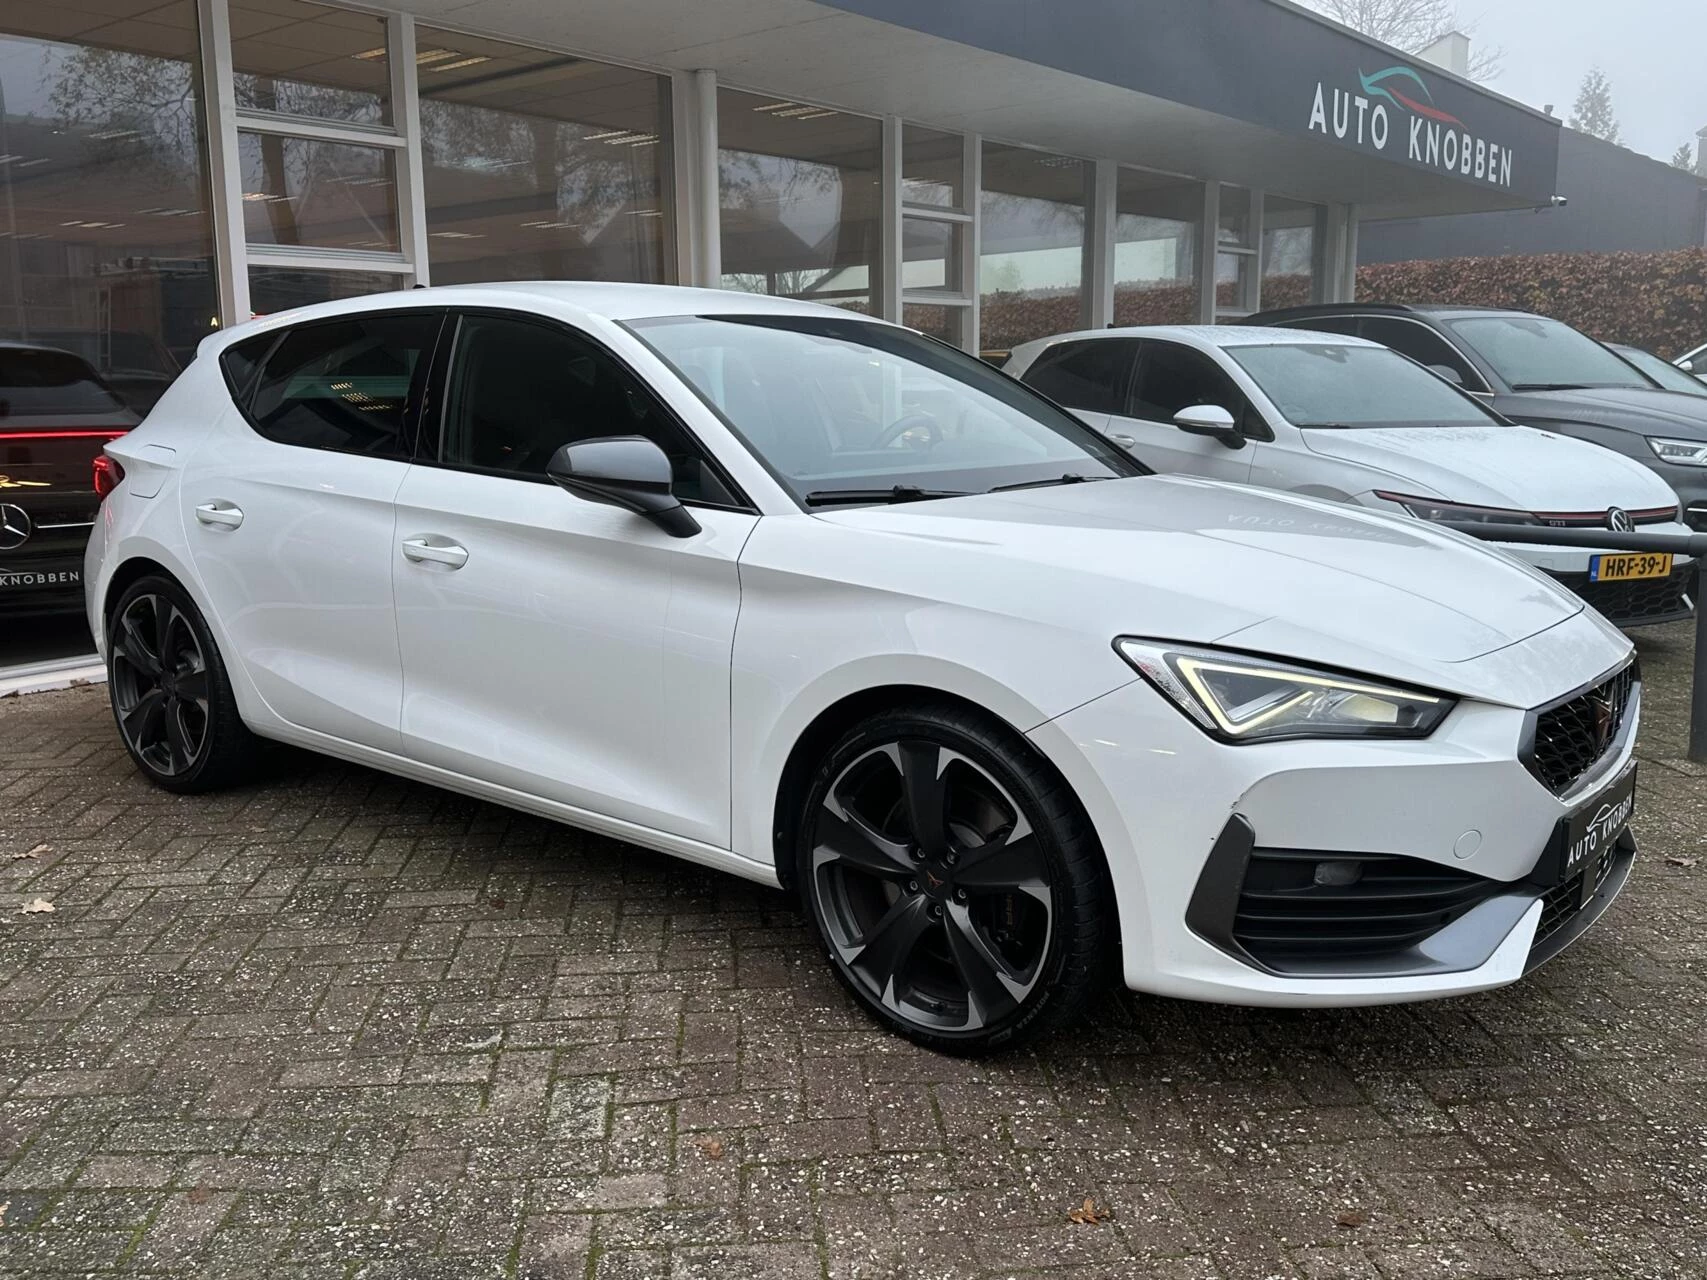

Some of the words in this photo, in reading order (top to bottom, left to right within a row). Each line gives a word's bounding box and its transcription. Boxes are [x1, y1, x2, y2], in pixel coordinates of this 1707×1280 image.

[1309, 81, 1389, 151] AUTO
[1409, 115, 1513, 188] KNOBBEN
[0, 571, 80, 586] KNOBBEN
[1604, 556, 1668, 577] HRF-39-J
[1567, 831, 1597, 868] AUTO
[1602, 792, 1633, 840] KNOBBEN
